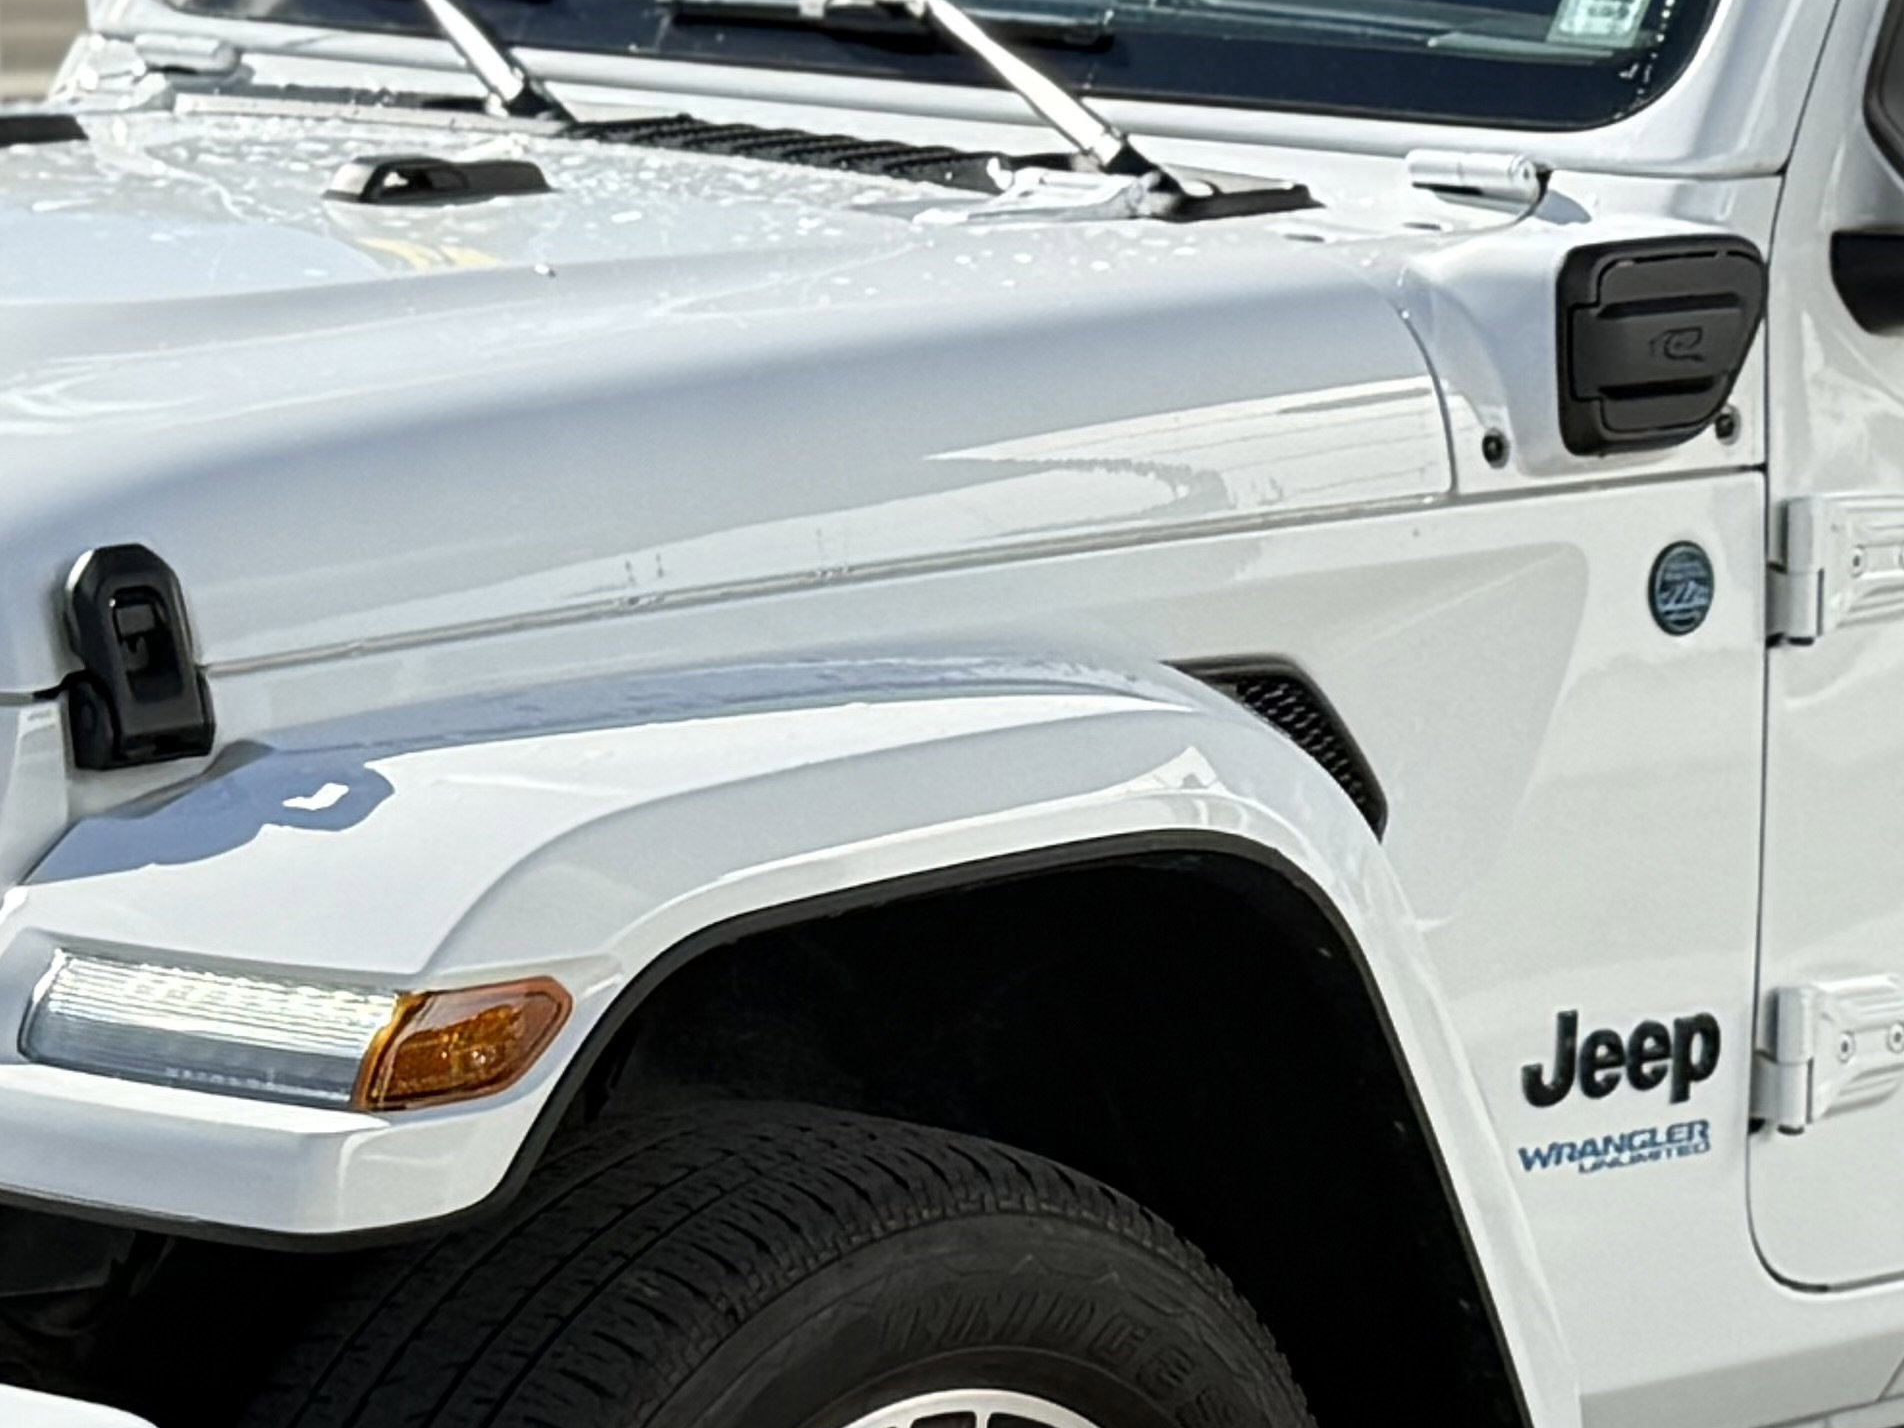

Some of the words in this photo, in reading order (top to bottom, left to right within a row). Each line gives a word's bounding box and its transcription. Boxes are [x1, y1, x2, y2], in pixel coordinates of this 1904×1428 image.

[1521, 1009, 1721, 1109] Jeep
[1517, 1118, 1710, 1173] WRANGLER
[1577, 1140, 1711, 1174] UNLIMITED
